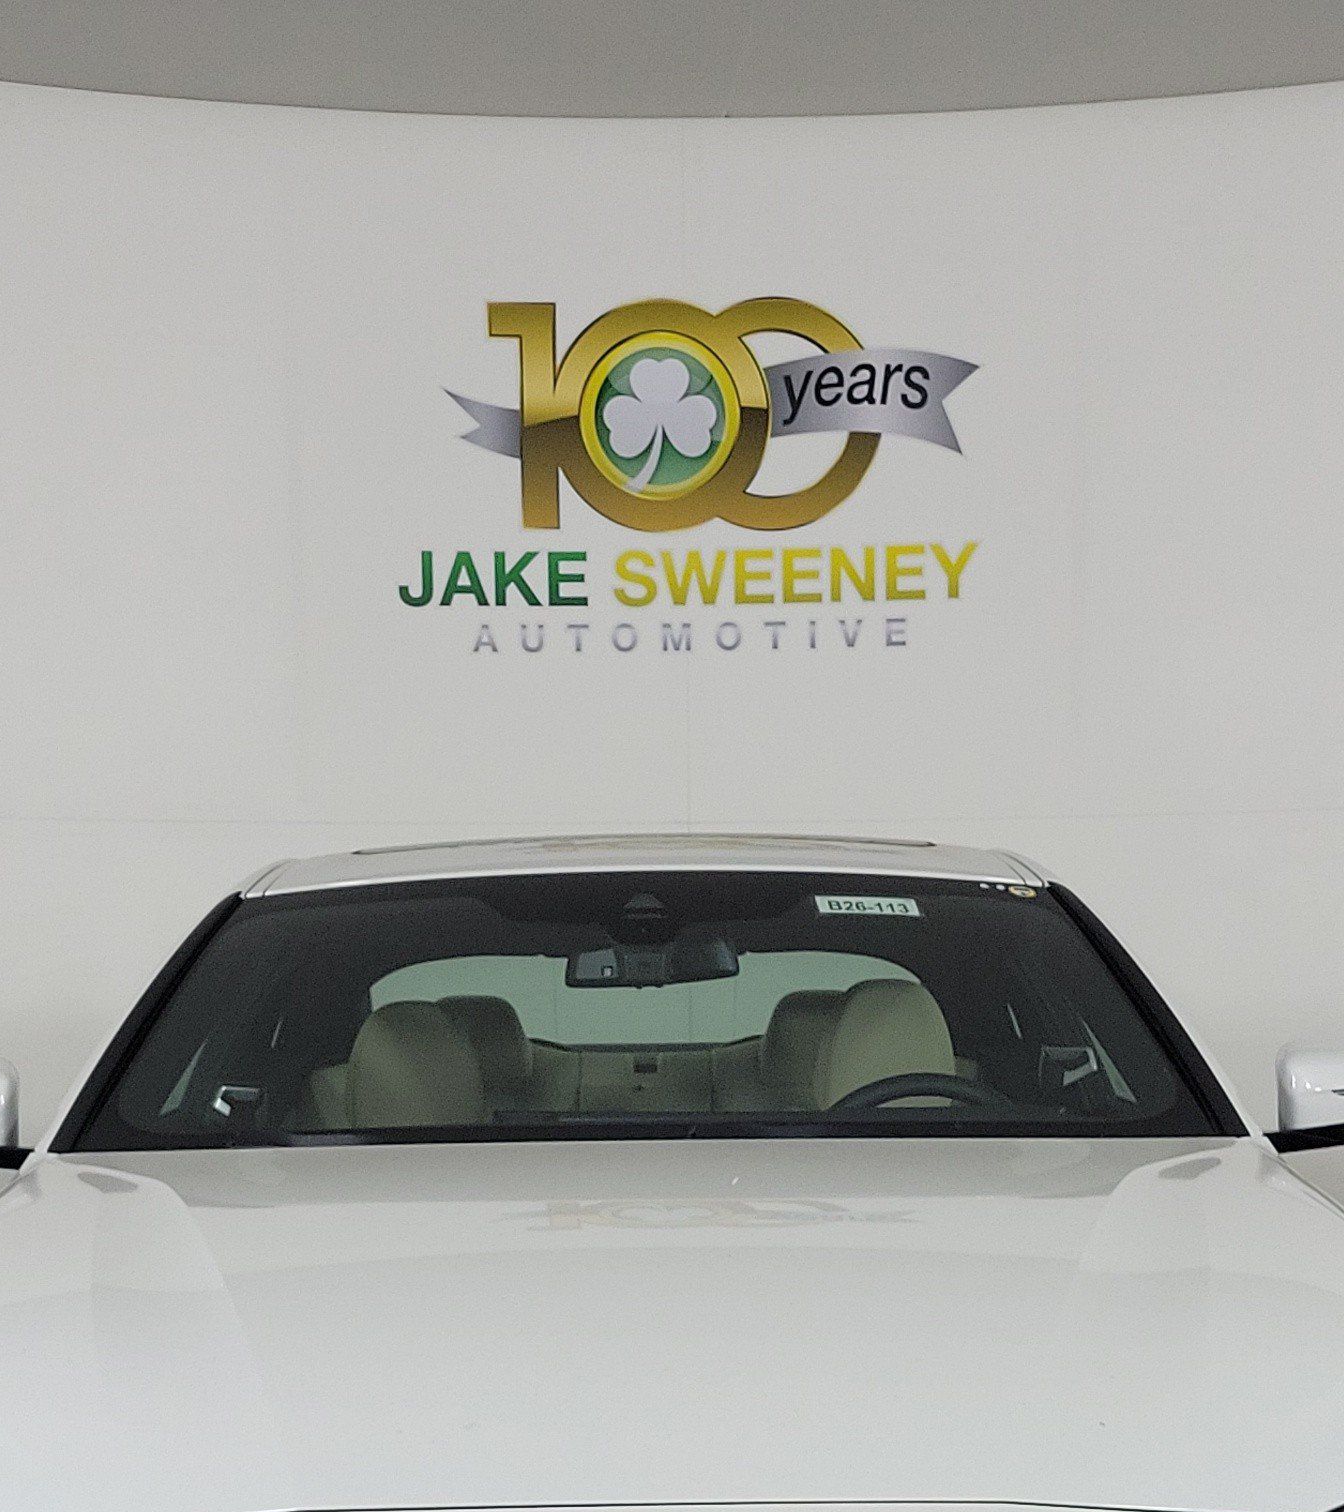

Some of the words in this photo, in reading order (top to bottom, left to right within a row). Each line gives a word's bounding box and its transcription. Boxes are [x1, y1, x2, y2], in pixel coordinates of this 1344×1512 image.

[486, 296, 882, 533] 100
[781, 362, 931, 426] years
[398, 549, 589, 607] JAKE
[613, 542, 979, 607] SWEENEY
[472, 618, 908, 654] AUTOMOTIVE
